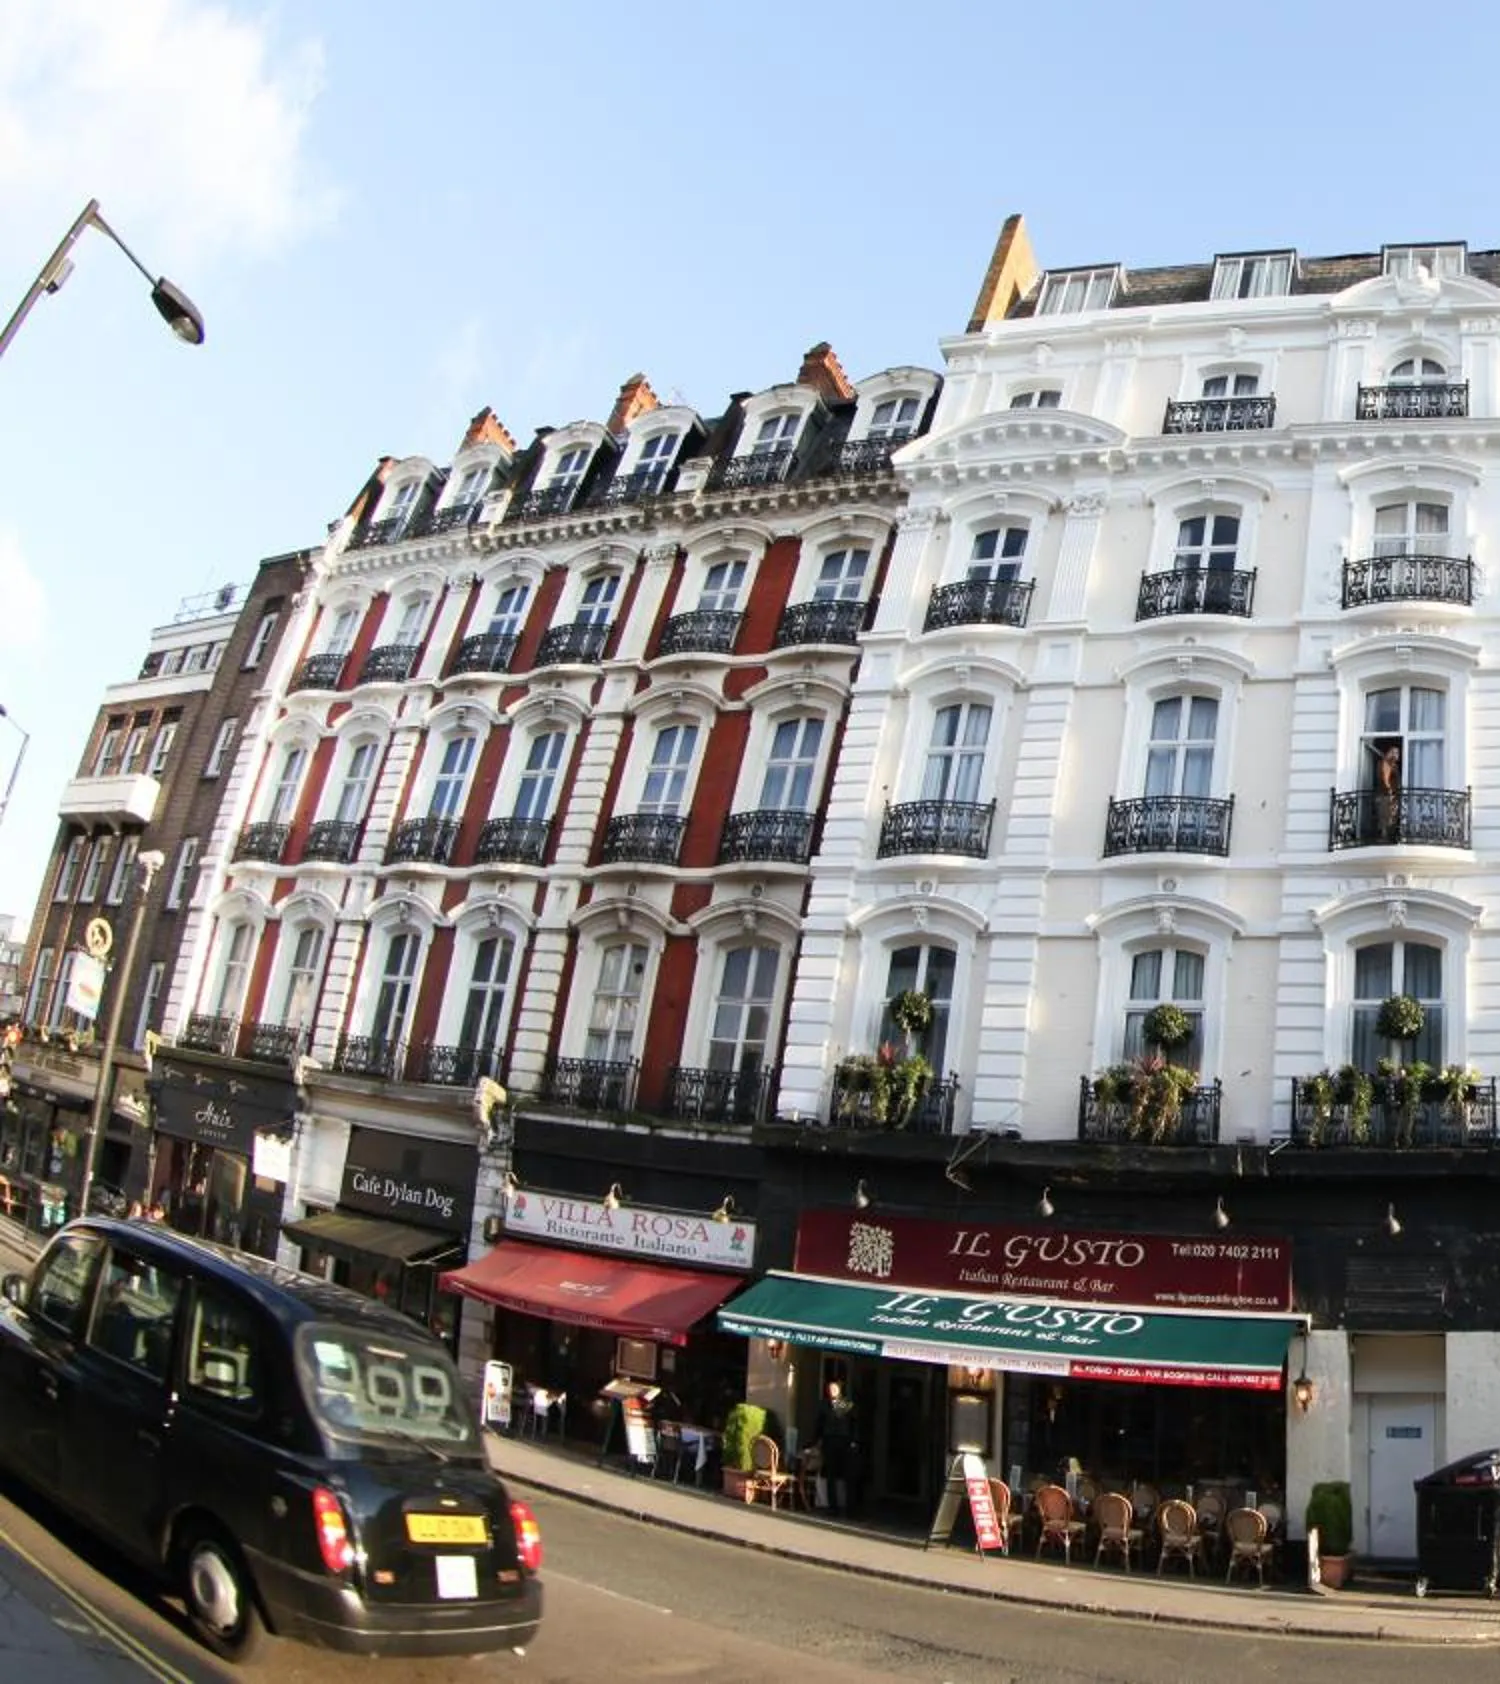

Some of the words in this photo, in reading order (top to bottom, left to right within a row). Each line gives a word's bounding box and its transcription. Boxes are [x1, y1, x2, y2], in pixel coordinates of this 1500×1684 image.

[383, 1179, 422, 1206] Dylan
[425, 1187, 455, 1217] Dog
[540, 1197, 615, 1228] VILLA
[631, 1212, 709, 1242] ROSA
[545, 1218, 626, 1245] Ristorante
[633, 1233, 698, 1257] Italiano
[950, 1231, 991, 1257] IL
[1004, 1234, 1145, 1268] GUSTO
[1219, 1245, 1249, 1259] 7402
[1251, 1245, 1280, 1260] 2111
[959, 1267, 999, 1284] Italian
[1001, 1271, 1069, 1290] Restaurant
[1090, 1279, 1114, 1294] Bar
[869, 1314, 929, 1327] Italian
[932, 1319, 1032, 1339] Restaurant
[875, 1293, 939, 1316] IL
[958, 1300, 1144, 1335] GUSTO
